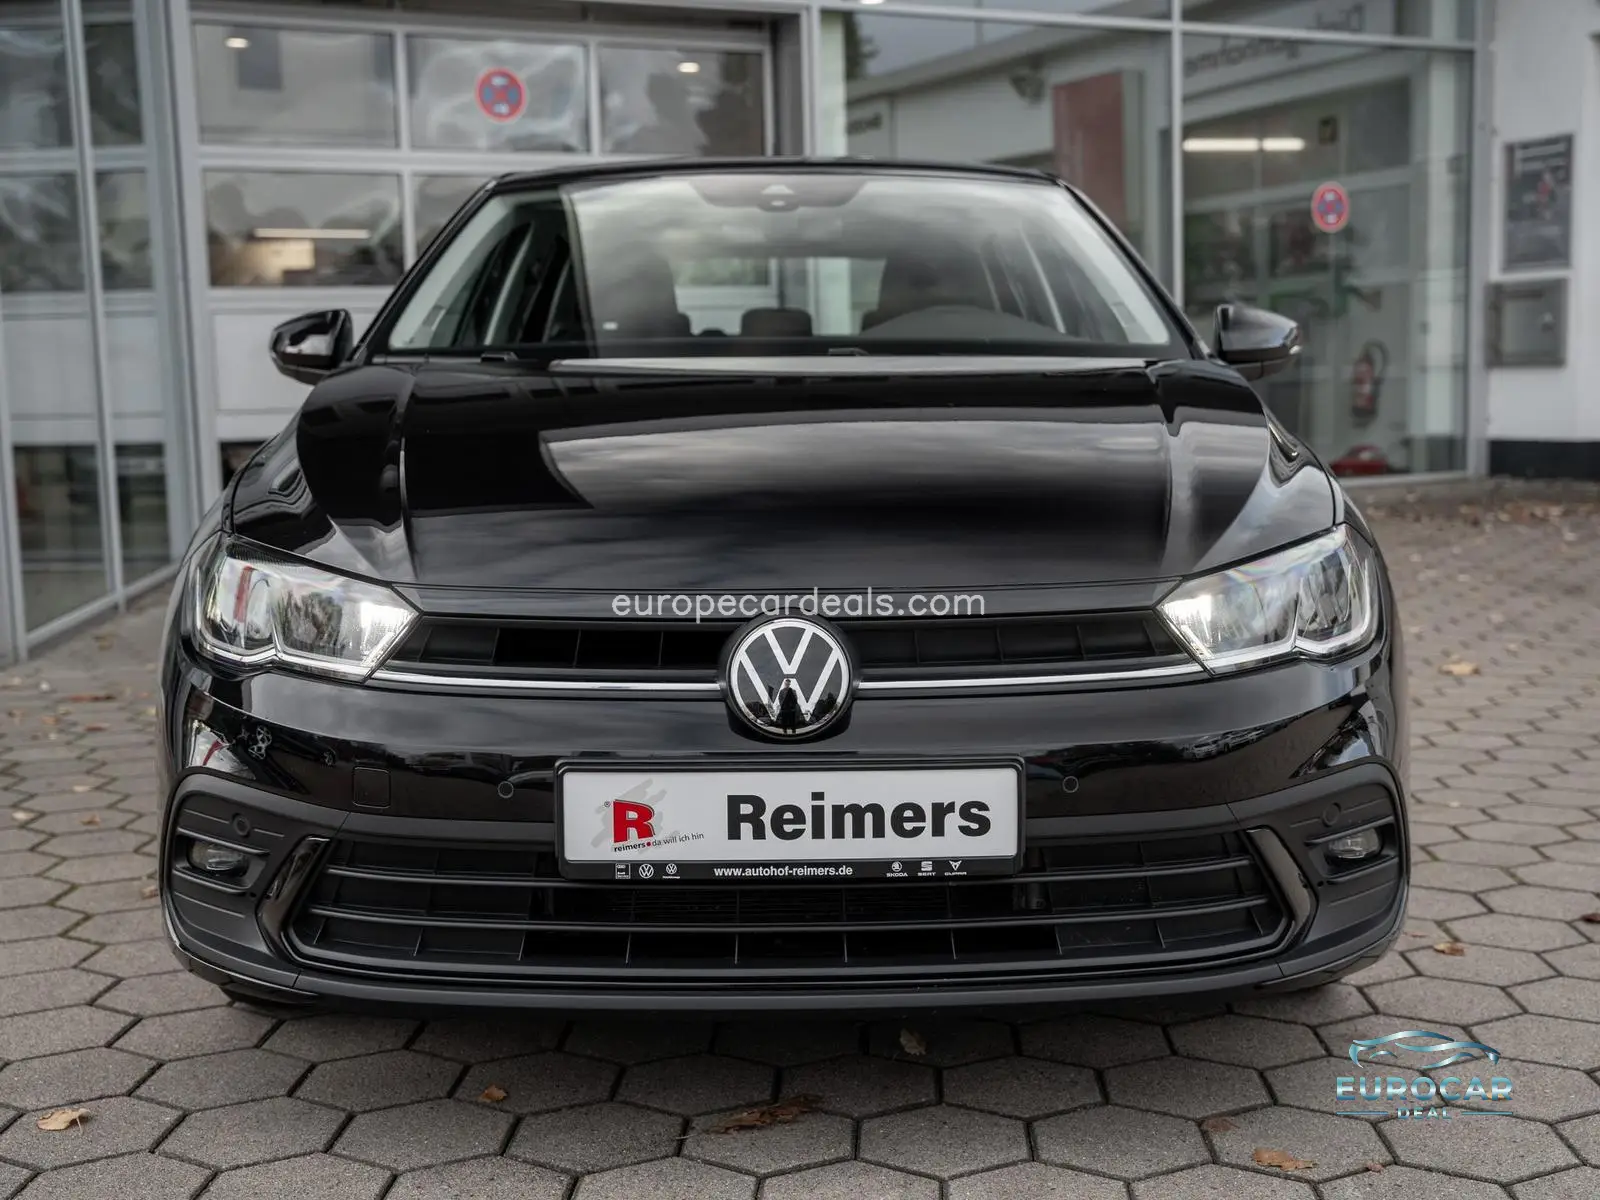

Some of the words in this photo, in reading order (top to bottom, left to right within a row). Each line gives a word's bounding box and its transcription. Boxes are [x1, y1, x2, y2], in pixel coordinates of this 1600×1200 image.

[726, 791, 992, 841] Reimers
[663, 836, 677, 844] will
[679, 834, 690, 842] ich
[691, 832, 705, 841] hin
[713, 865, 853, 877] www.autohof-reimers.de
